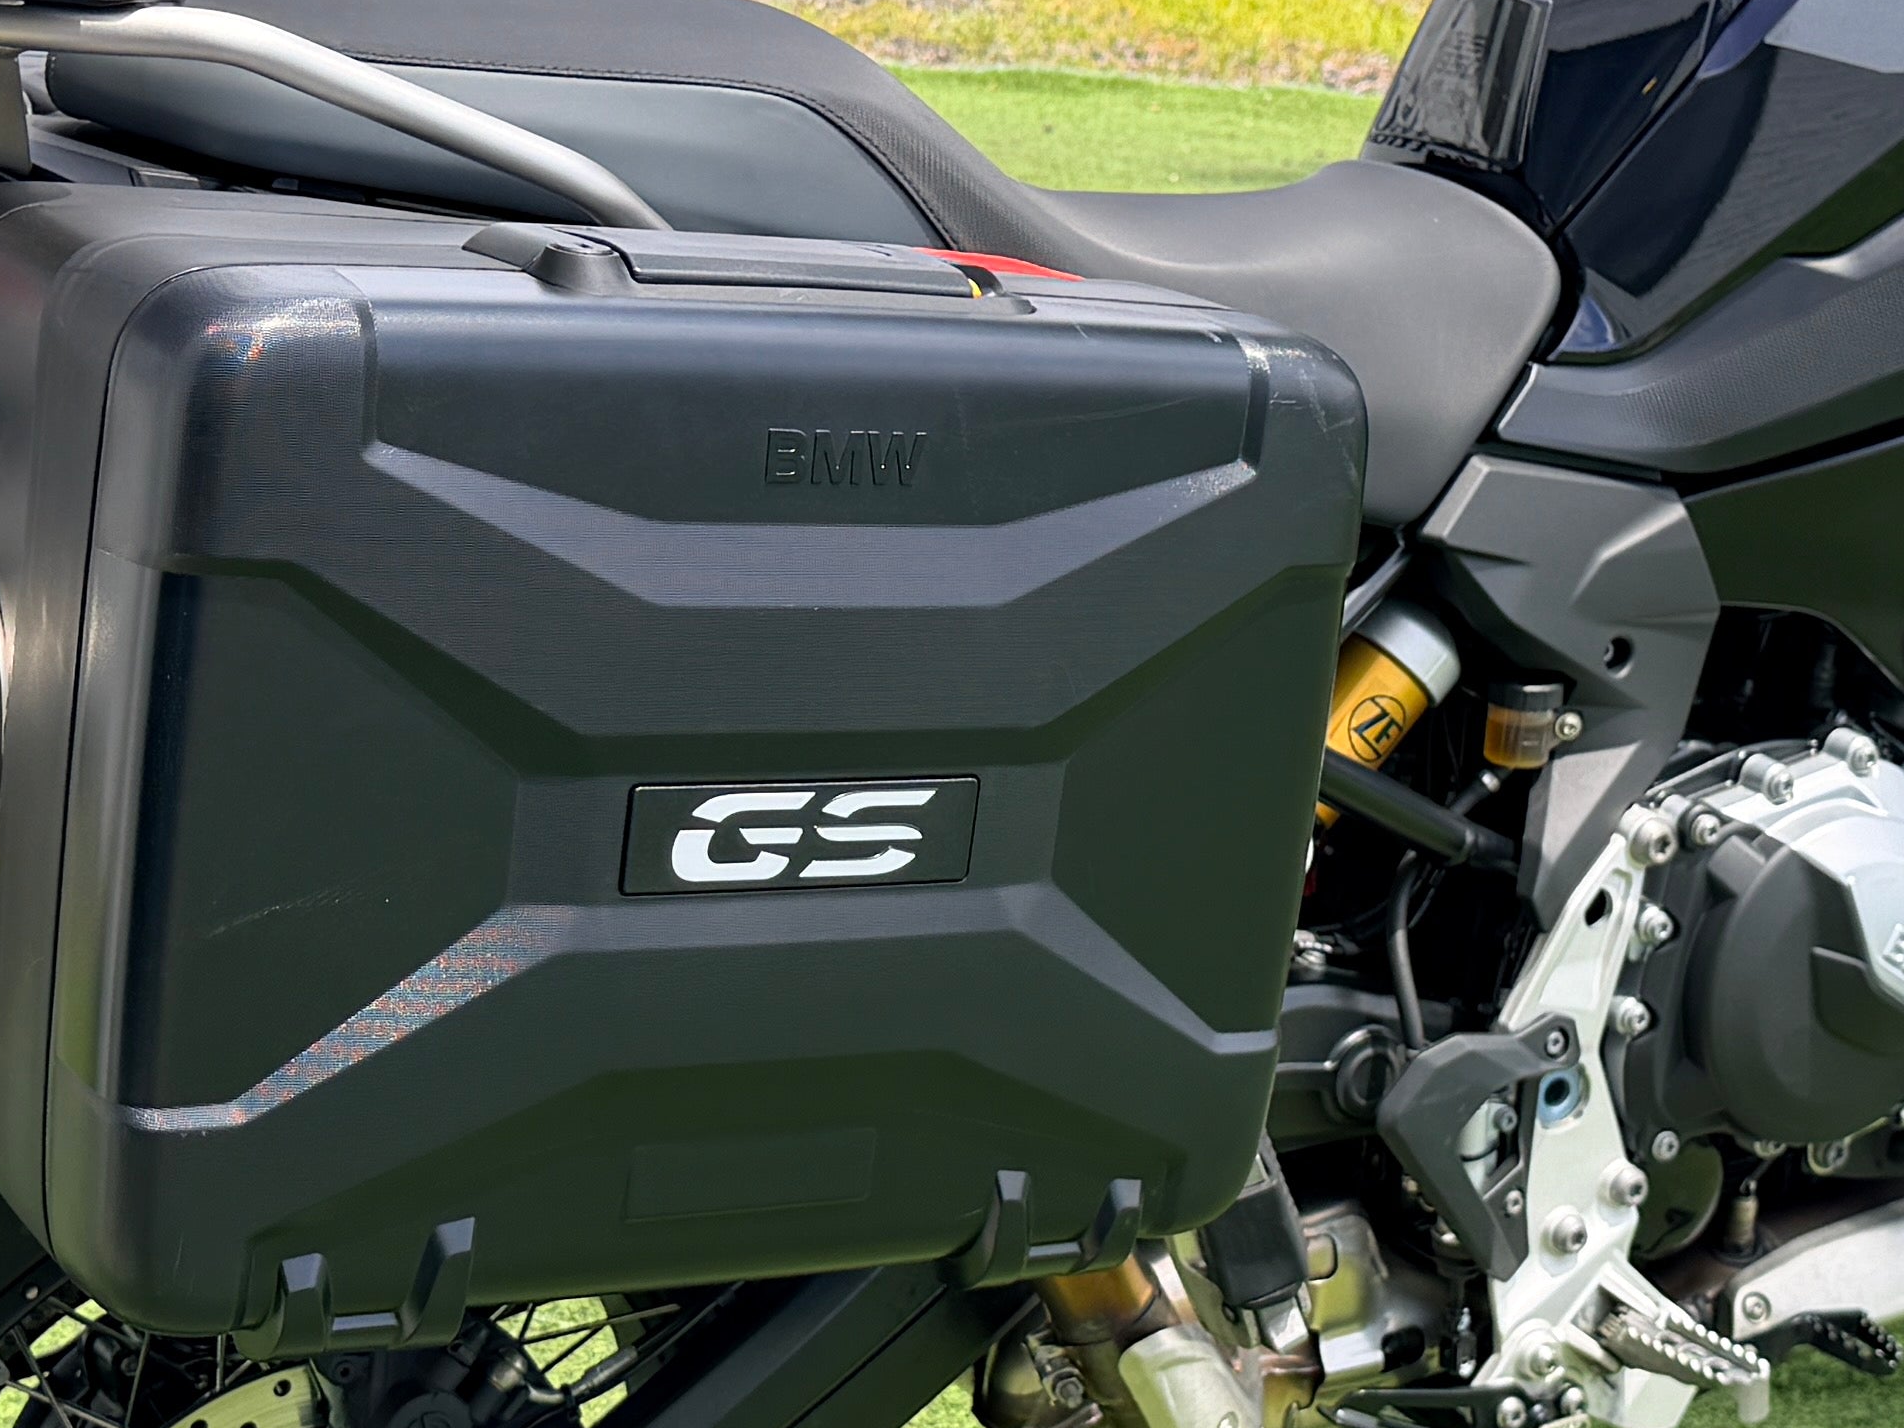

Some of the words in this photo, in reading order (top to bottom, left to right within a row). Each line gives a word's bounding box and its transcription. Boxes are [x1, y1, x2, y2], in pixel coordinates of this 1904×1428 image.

[764, 427, 928, 487] BMW
[1349, 696, 1406, 762] ZF
[671, 789, 938, 883] GS
